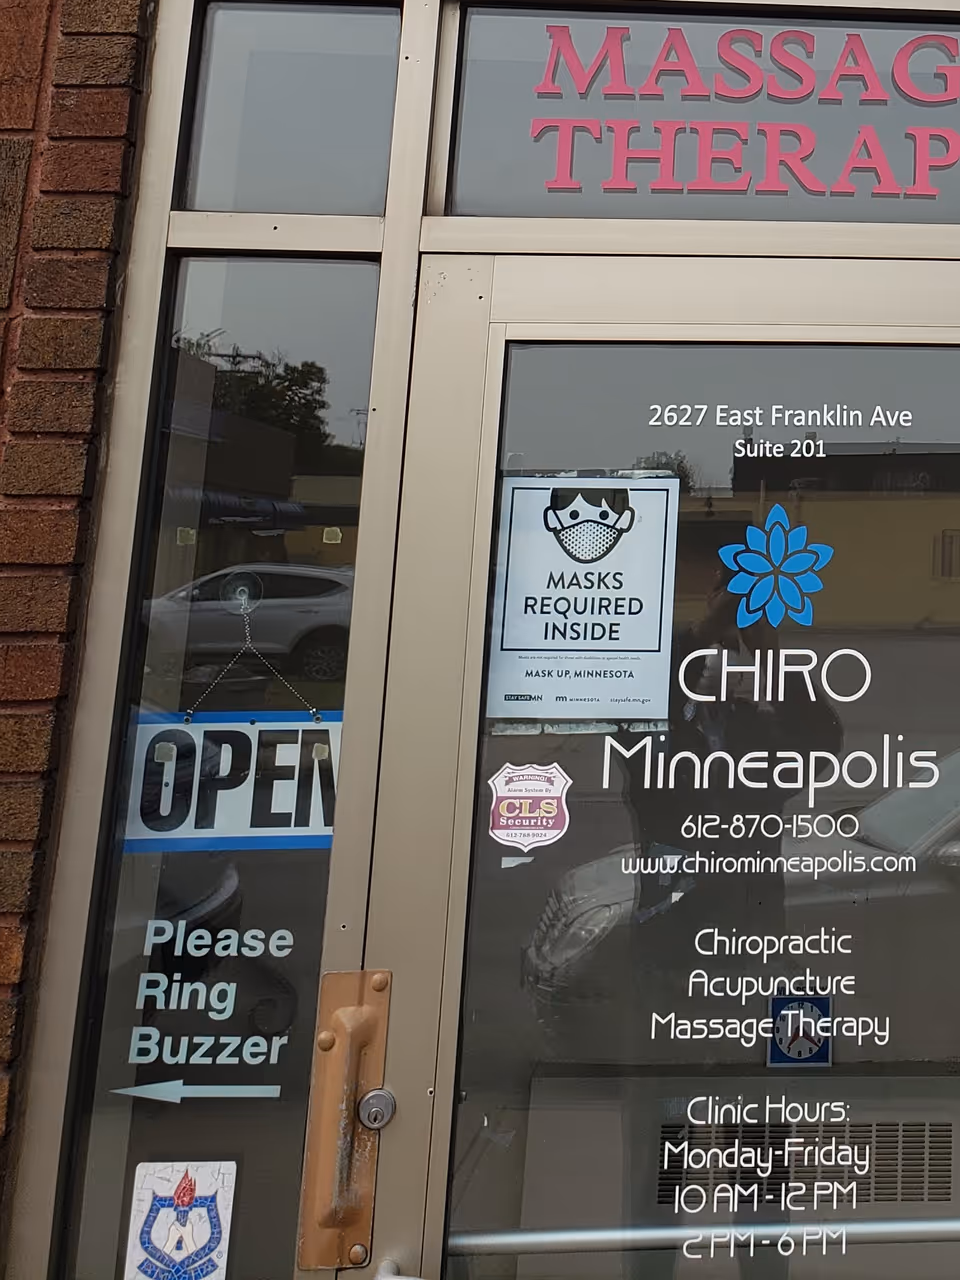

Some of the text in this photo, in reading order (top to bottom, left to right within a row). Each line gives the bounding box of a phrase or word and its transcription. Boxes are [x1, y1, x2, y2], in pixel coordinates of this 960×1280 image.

[649, 403, 913, 428] 2627 East Franklin Ave
[734, 439, 826, 459] Suite 201
[546, 571, 624, 590] MASKS
[524, 596, 644, 620] REQUIRED
[544, 622, 621, 641] INSIDE
[525, 669, 635, 680] MASK UP, MINNESOTA
[678, 648, 872, 702] CHIRO
[602, 734, 940, 808] Minneapolis
[499, 799, 558, 817] CLS
[499, 817, 555, 827] Security
[681, 814, 859, 839] 612-870-1500
[621, 850, 917, 880] www.chirominneapolis.com
[143, 920, 294, 959] Please
[694, 927, 852, 964] Chiropractic
[136, 973, 237, 1020] Ring
[688, 968, 856, 1006] Acupuncture
[651, 1009, 890, 1048] Massage Therapy
[128, 1026, 288, 1065] Buzzer
[686, 1095, 851, 1125] Clinic Hours:
[663, 1137, 870, 1177] Monday-Friday
[674, 1184, 707, 1214] 10
[713, 1183, 757, 1212] AM
[781, 1181, 806, 1211] 12
[813, 1181, 857, 1210] PM
[683, 1230, 703, 1259] 2
[710, 1228, 755, 1258] PM
[777, 1227, 795, 1256] 6
[803, 1225, 847, 1256] PM
